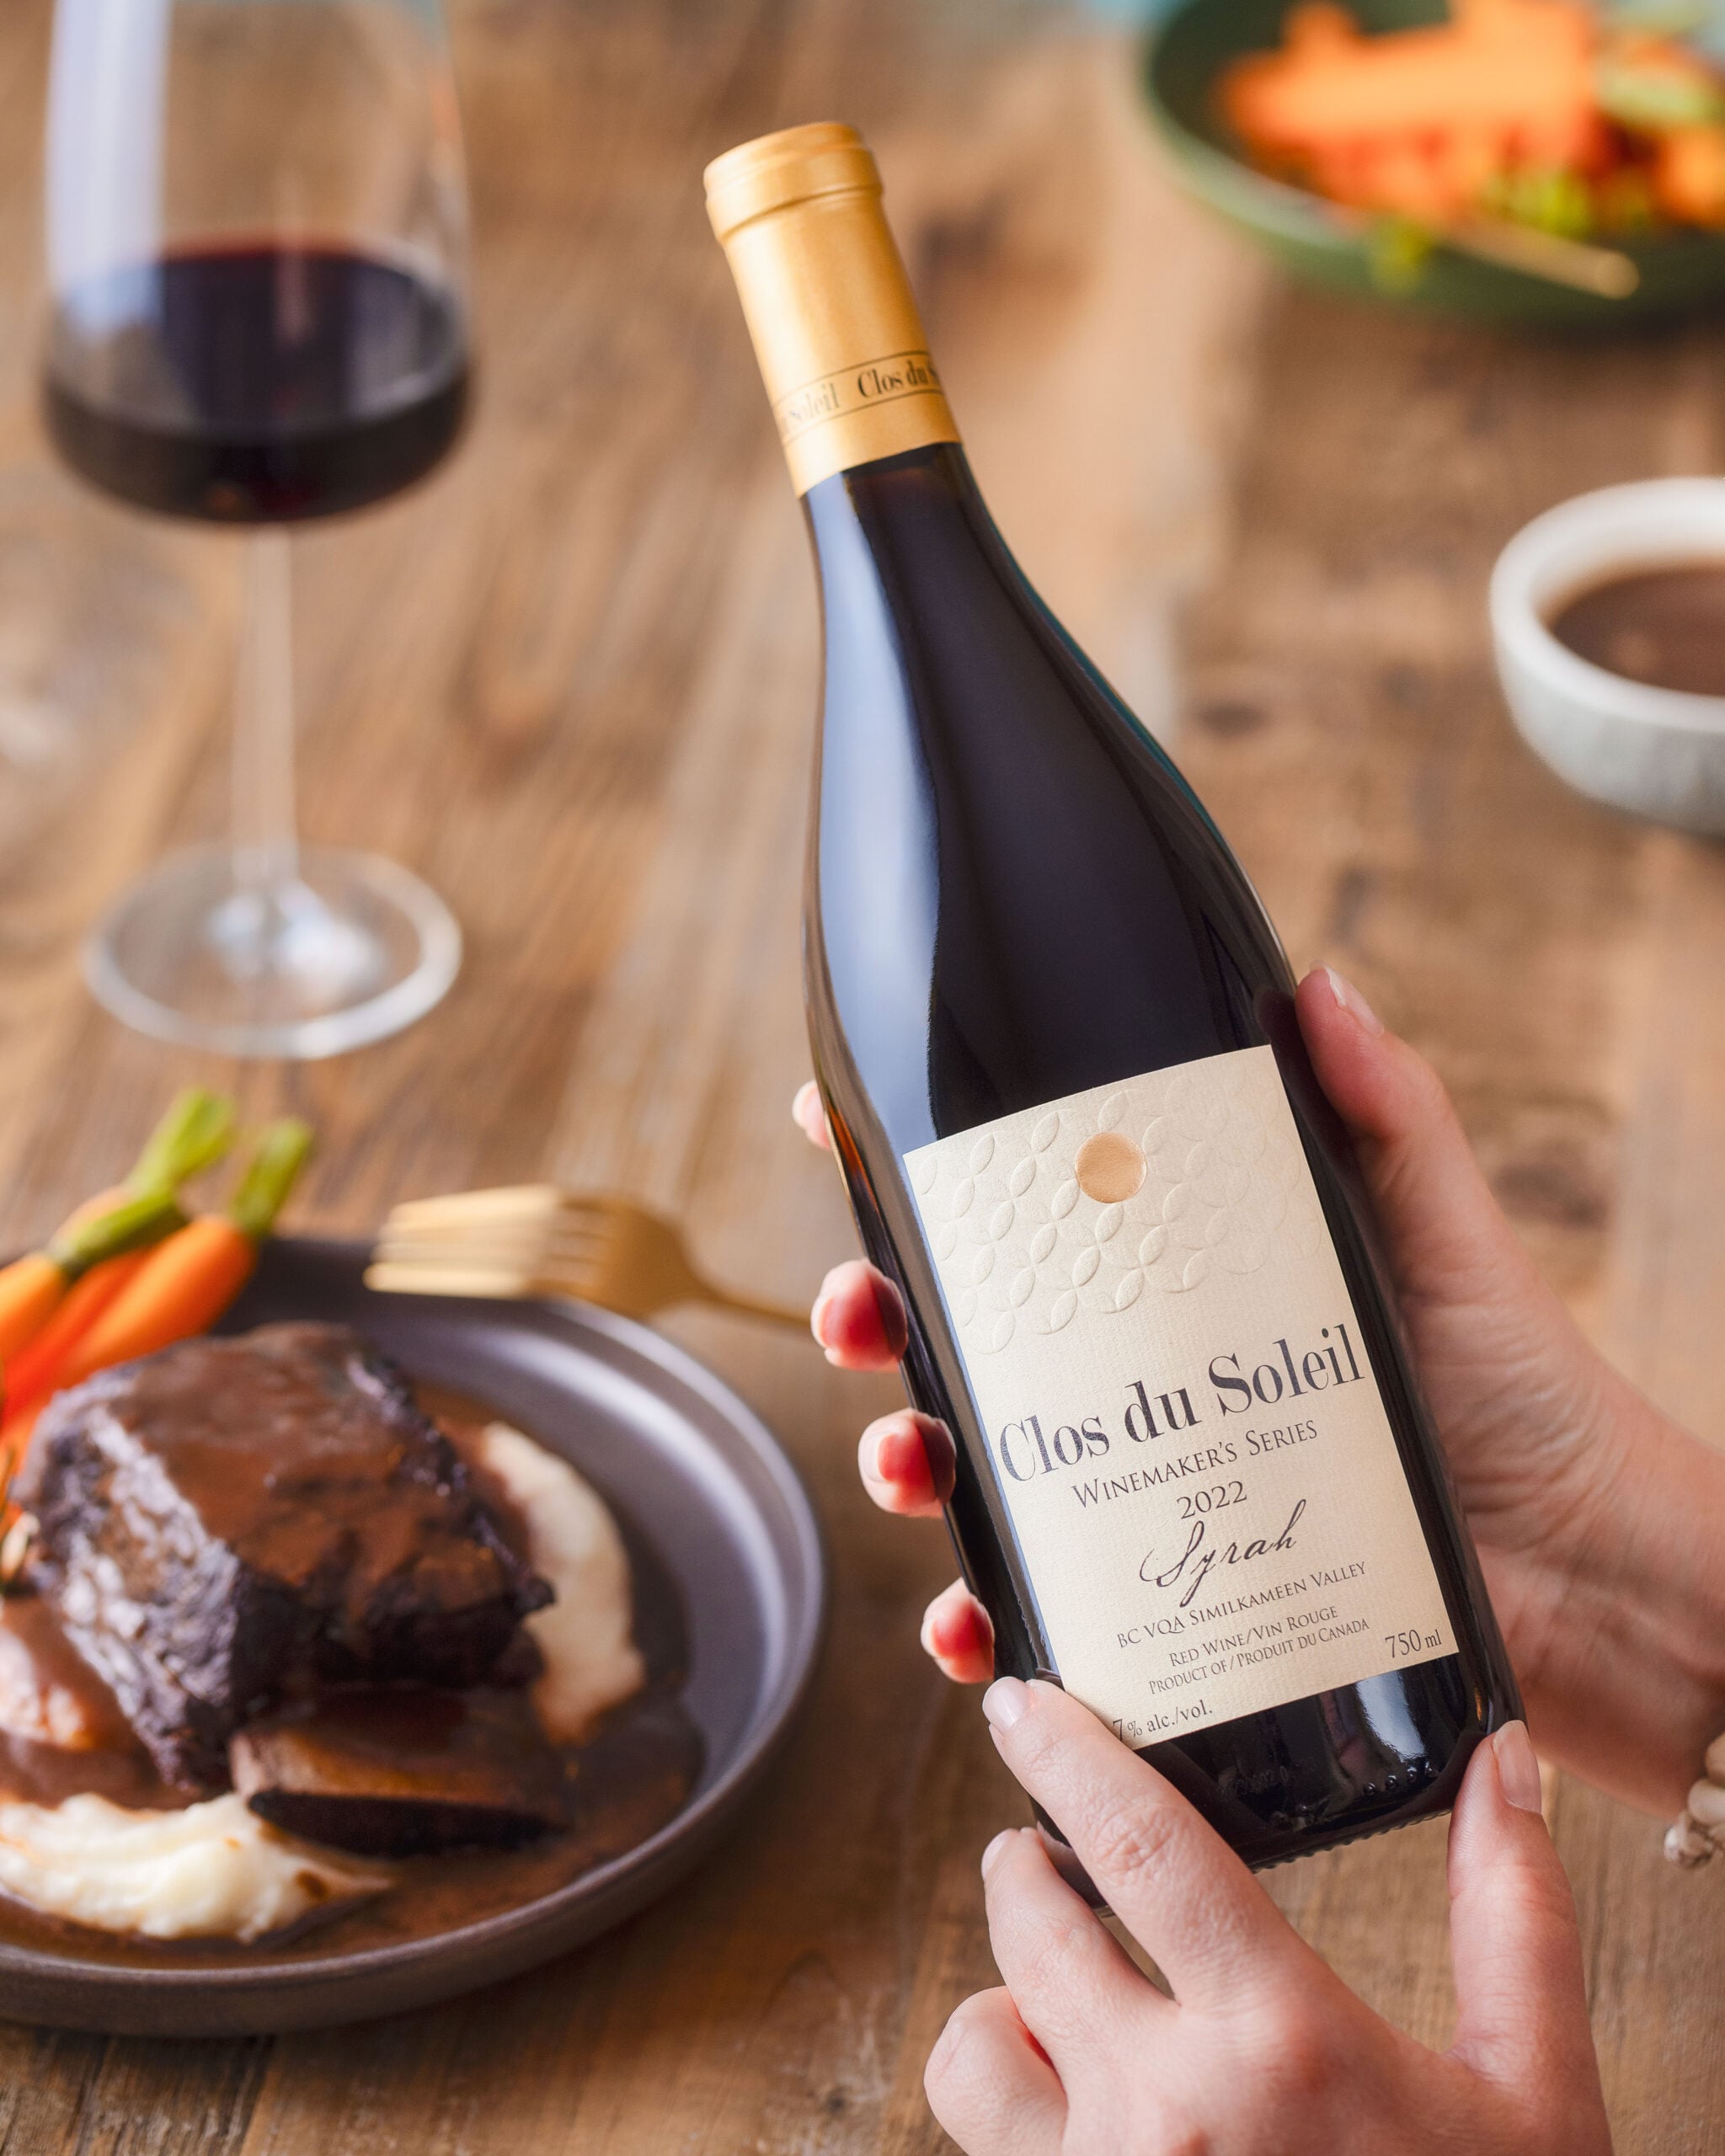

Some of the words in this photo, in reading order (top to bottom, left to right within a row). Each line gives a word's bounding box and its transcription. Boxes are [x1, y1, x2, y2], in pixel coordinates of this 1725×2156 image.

[857, 368, 903, 398] Clos
[1000, 1415, 1111, 1481] Clos
[1124, 1380, 1203, 1443] du
[1208, 1323, 1366, 1417] Soleil
[1071, 1442, 1238, 1508] WINEMAKER'S
[1245, 1419, 1319, 1456] SERIES
[1176, 1481, 1248, 1520] 2022
[1139, 1498, 1307, 1609] Syrah
[1116, 1628, 1142, 1648] BC
[1142, 1614, 1187, 1638] VQA
[1188, 1577, 1308, 1626] SIMILKAMEEN
[1309, 1561, 1367, 1588] VALLEY
[1168, 1648, 1200, 1668] RED
[1200, 1620, 1284, 1657] WINE/VIN
[1285, 1605, 1339, 1631] ROUGE
[1148, 1665, 1209, 1695] PRODUCT
[1297, 1636, 1317, 1650] DU
[1317, 1618, 1370, 1643] CANADA
[1384, 1628, 1423, 1659] 750
[1423, 1629, 1443, 1649] ml
[1146, 1699, 1214, 1733] alc./vol.
